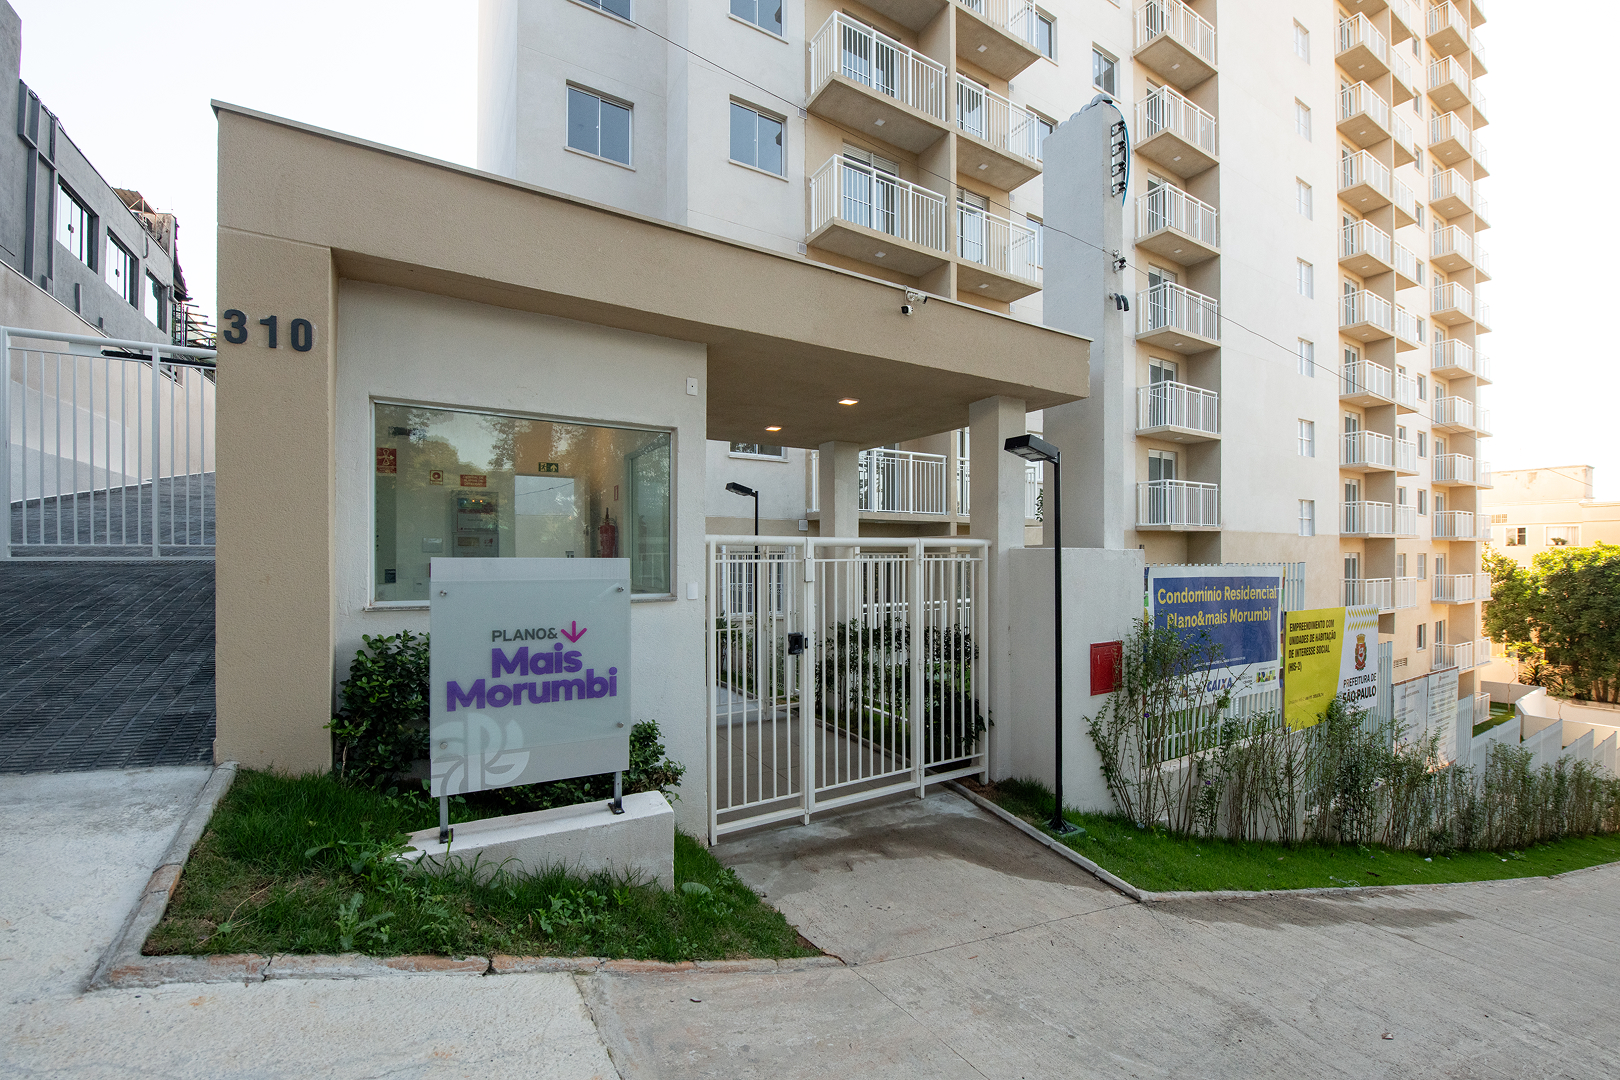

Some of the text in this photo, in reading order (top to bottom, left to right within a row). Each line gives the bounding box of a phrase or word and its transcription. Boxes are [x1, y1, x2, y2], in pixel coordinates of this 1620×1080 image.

[223, 308, 313, 353] 310
[1157, 584, 1278, 605] Condomínio Residencial
[1167, 606, 1272, 630] Plano&mais Morumbi
[1289, 619, 1335, 632] EMPREENDIMENTO COM
[491, 627, 558, 643] PLANO&
[1289, 629, 1337, 646] UNIDADES DE HABITAÇÃO
[1288, 644, 1331, 659] DE INTERESSE SOCIAL
[491, 642, 583, 679] Mais
[1206, 676, 1233, 693] CAIXA
[1342, 672, 1377, 688] PREFEITURA DE
[446, 666, 618, 712] Morumbi
[1342, 688, 1356, 703] SÃO
[1356, 685, 1377, 701] PAULO
